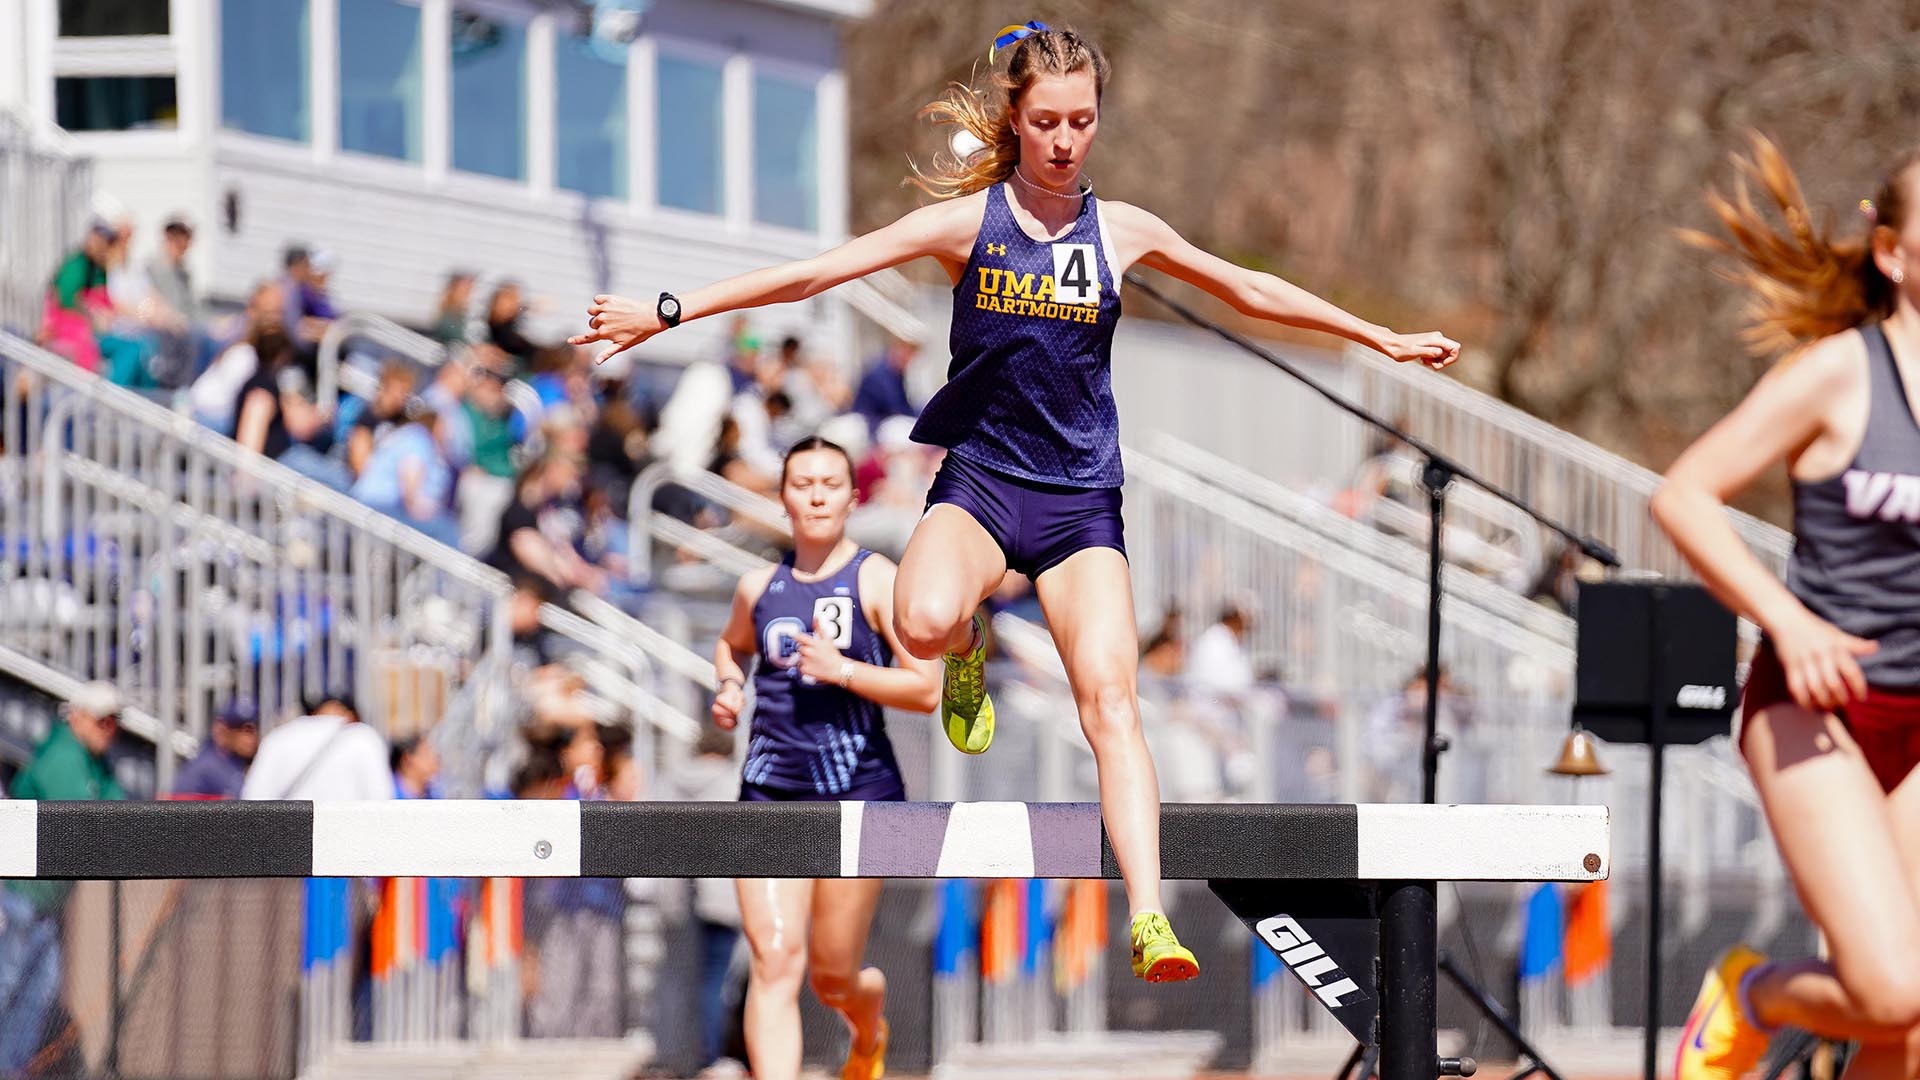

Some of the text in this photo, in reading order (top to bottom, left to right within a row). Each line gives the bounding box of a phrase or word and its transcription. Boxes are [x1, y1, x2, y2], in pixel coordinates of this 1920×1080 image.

[1060, 248, 1091, 298] 4
[975, 293, 1099, 324] DARTMOUTH
[822, 602, 842, 640] 3
[1256, 913, 1360, 1008] GILL
